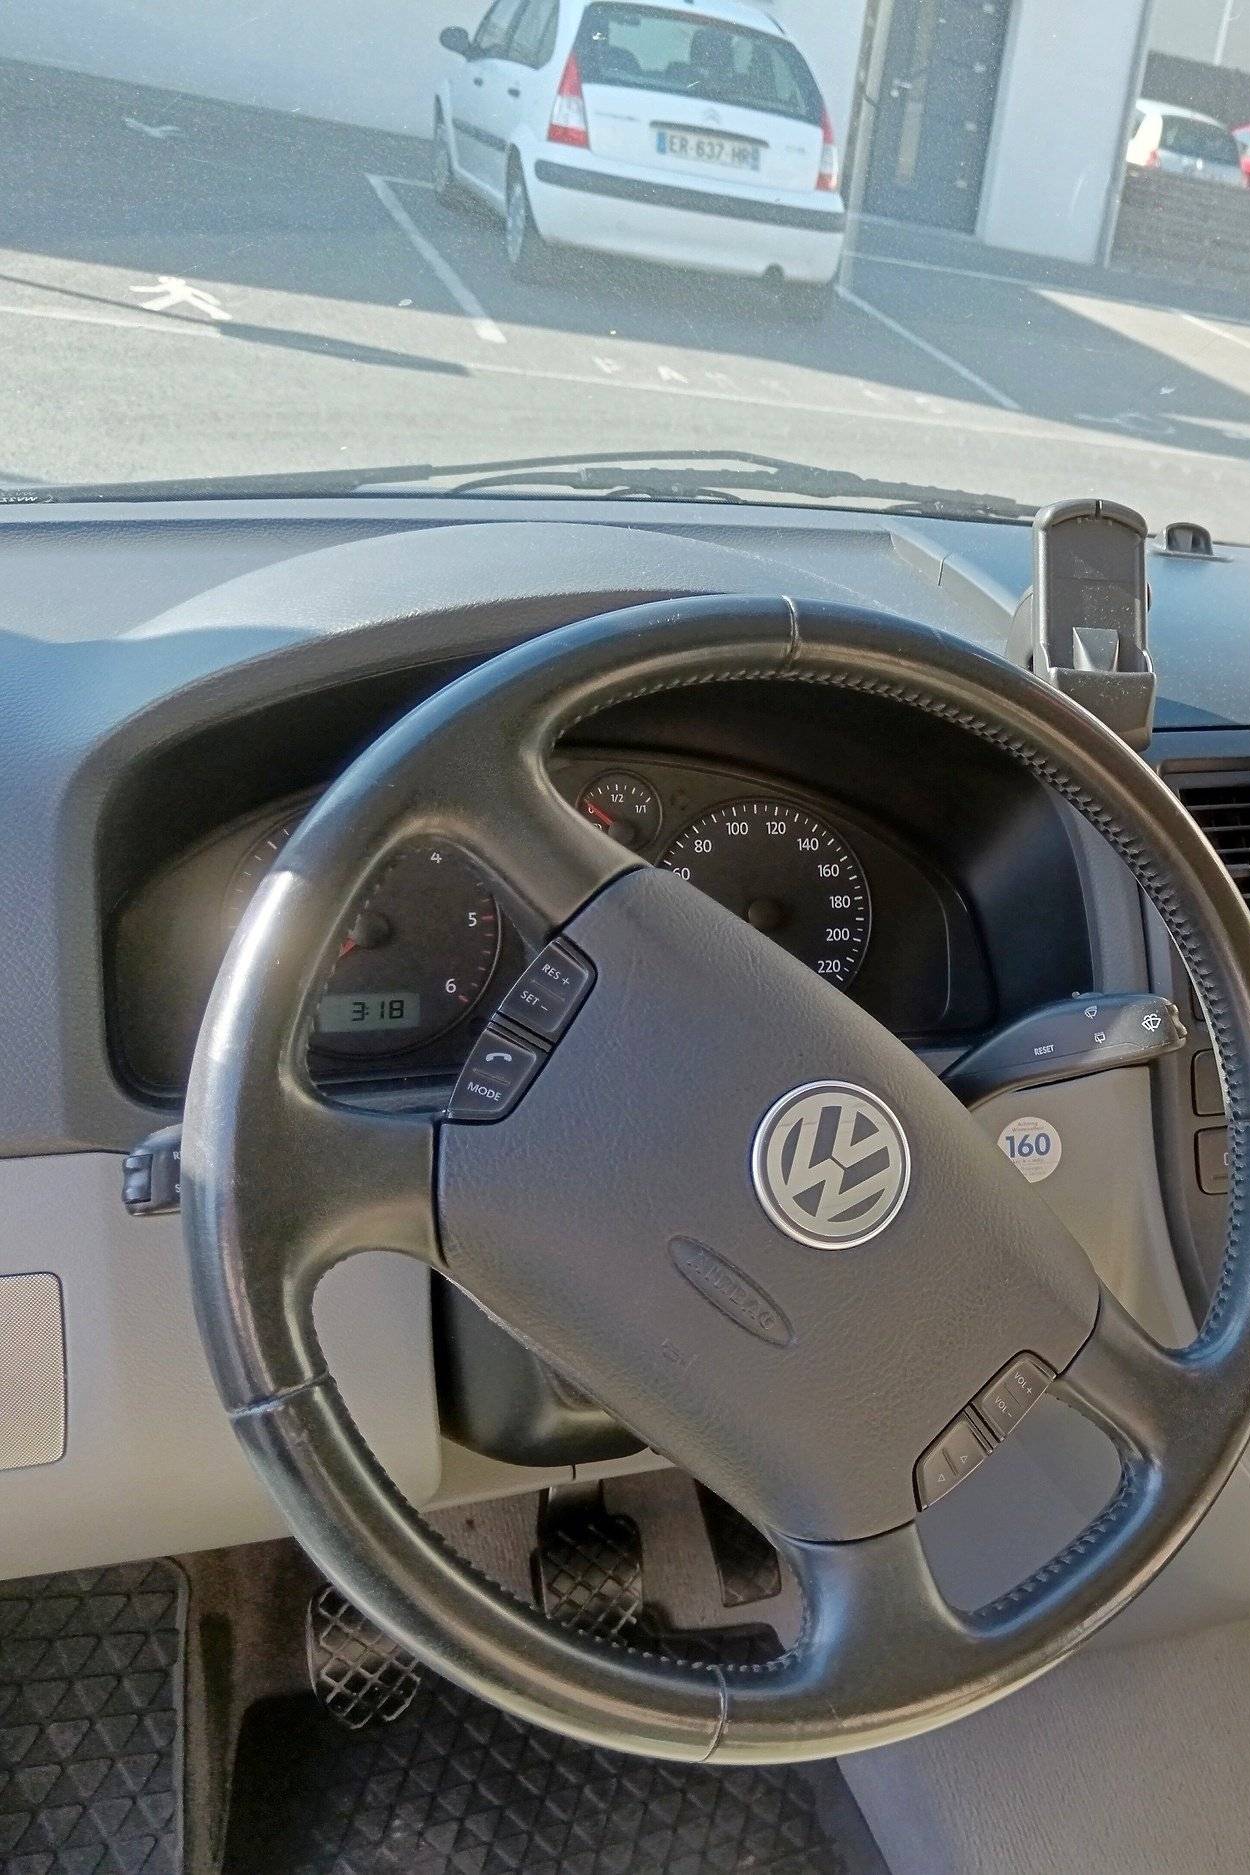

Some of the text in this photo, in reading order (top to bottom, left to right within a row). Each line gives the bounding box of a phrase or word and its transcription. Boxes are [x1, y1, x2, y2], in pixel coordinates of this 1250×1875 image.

[610, 793, 624, 803] 1/2
[726, 822, 749, 835] 100
[766, 821, 786, 835] 120
[694, 839, 712, 853] 80
[797, 837, 819, 851] 140
[430, 851, 443, 864] 4
[817, 864, 840, 878] 160
[829, 895, 851, 909] 180
[467, 911, 478, 927] 5
[826, 928, 850, 942] 200
[542, 963, 561, 980] RES
[817, 960, 841, 974] 220
[445, 978, 457, 994] 6
[520, 990, 540, 1006] SET
[351, 999, 405, 1022] 3:18
[1033, 1043, 1055, 1056] RESET
[467, 1081, 502, 1102] MODE
[1005, 1132, 1051, 1158] 160
